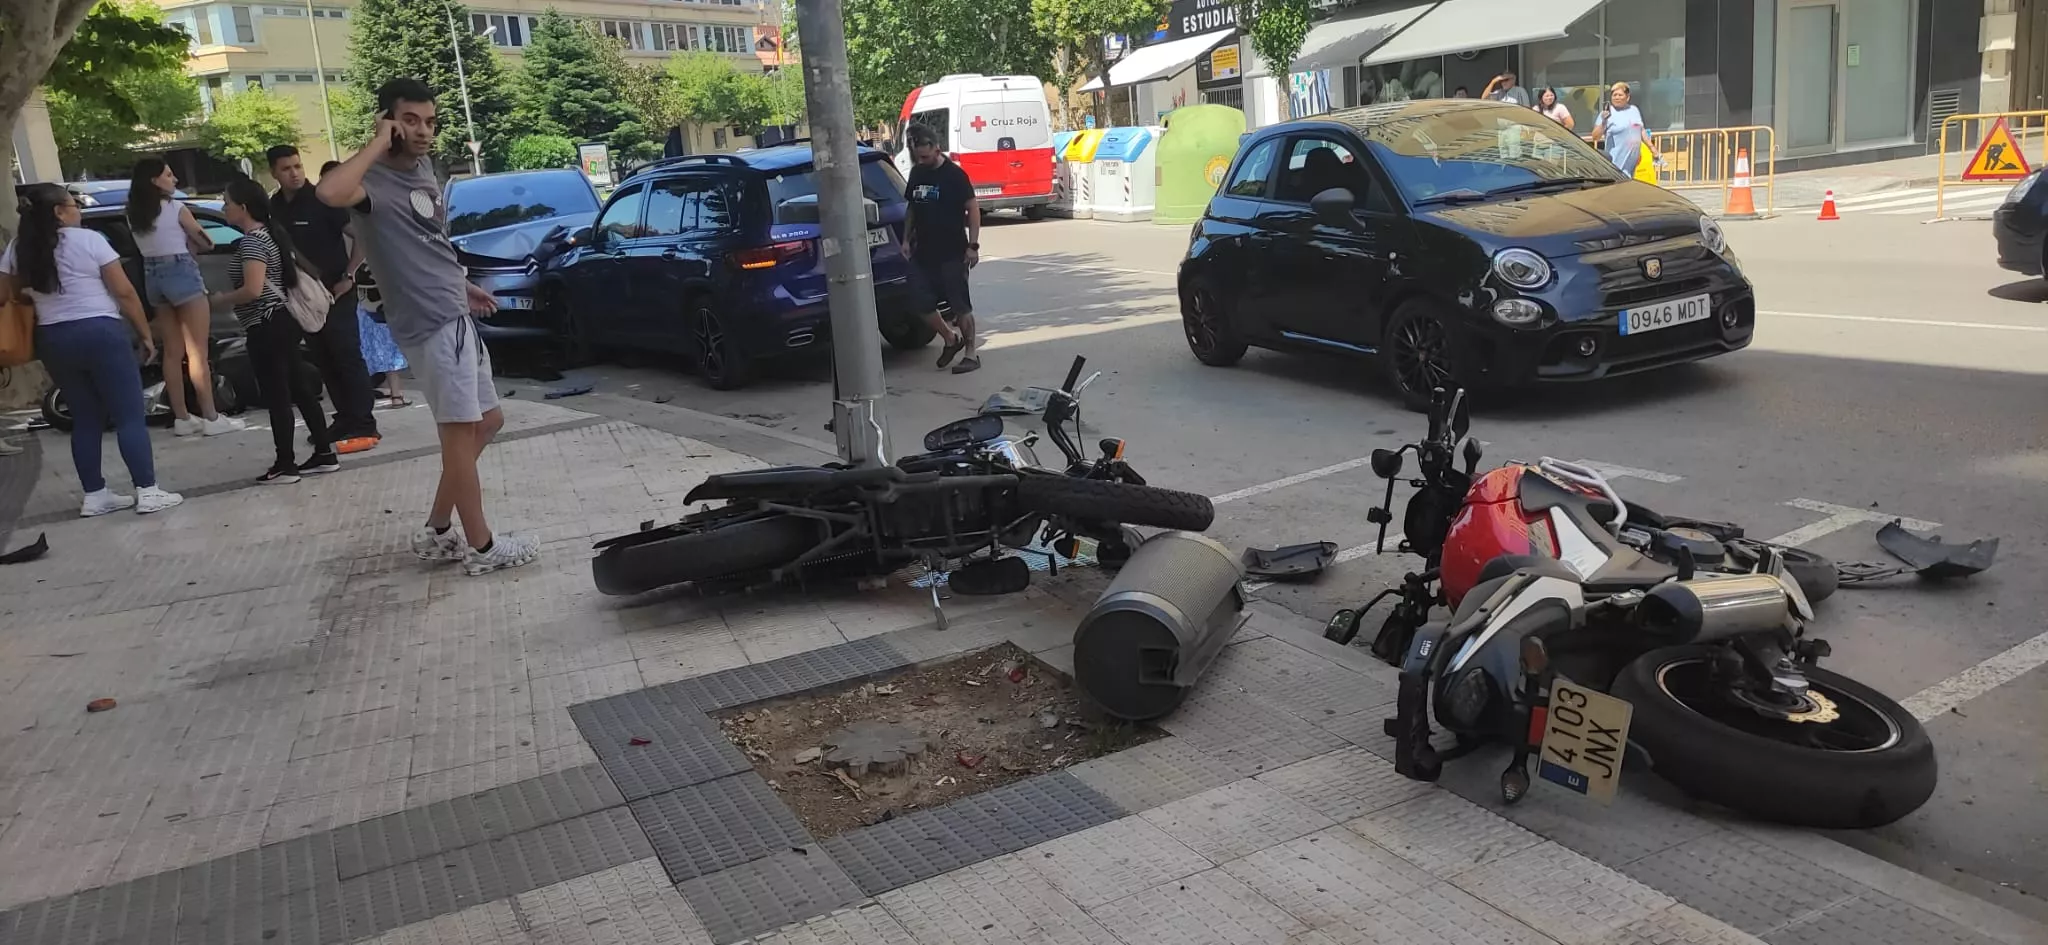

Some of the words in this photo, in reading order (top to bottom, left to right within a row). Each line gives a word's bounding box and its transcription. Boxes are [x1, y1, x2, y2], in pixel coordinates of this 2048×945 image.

[991, 118, 1015, 126] Cruz
[1016, 116, 1038, 126] Roja
[1631, 306, 1672, 330] 0946
[1677, 298, 1705, 320] MDT
[1548, 687, 1587, 764] 4103
[1583, 719, 1620, 779] JNX
[1567, 775, 1580, 787] E
